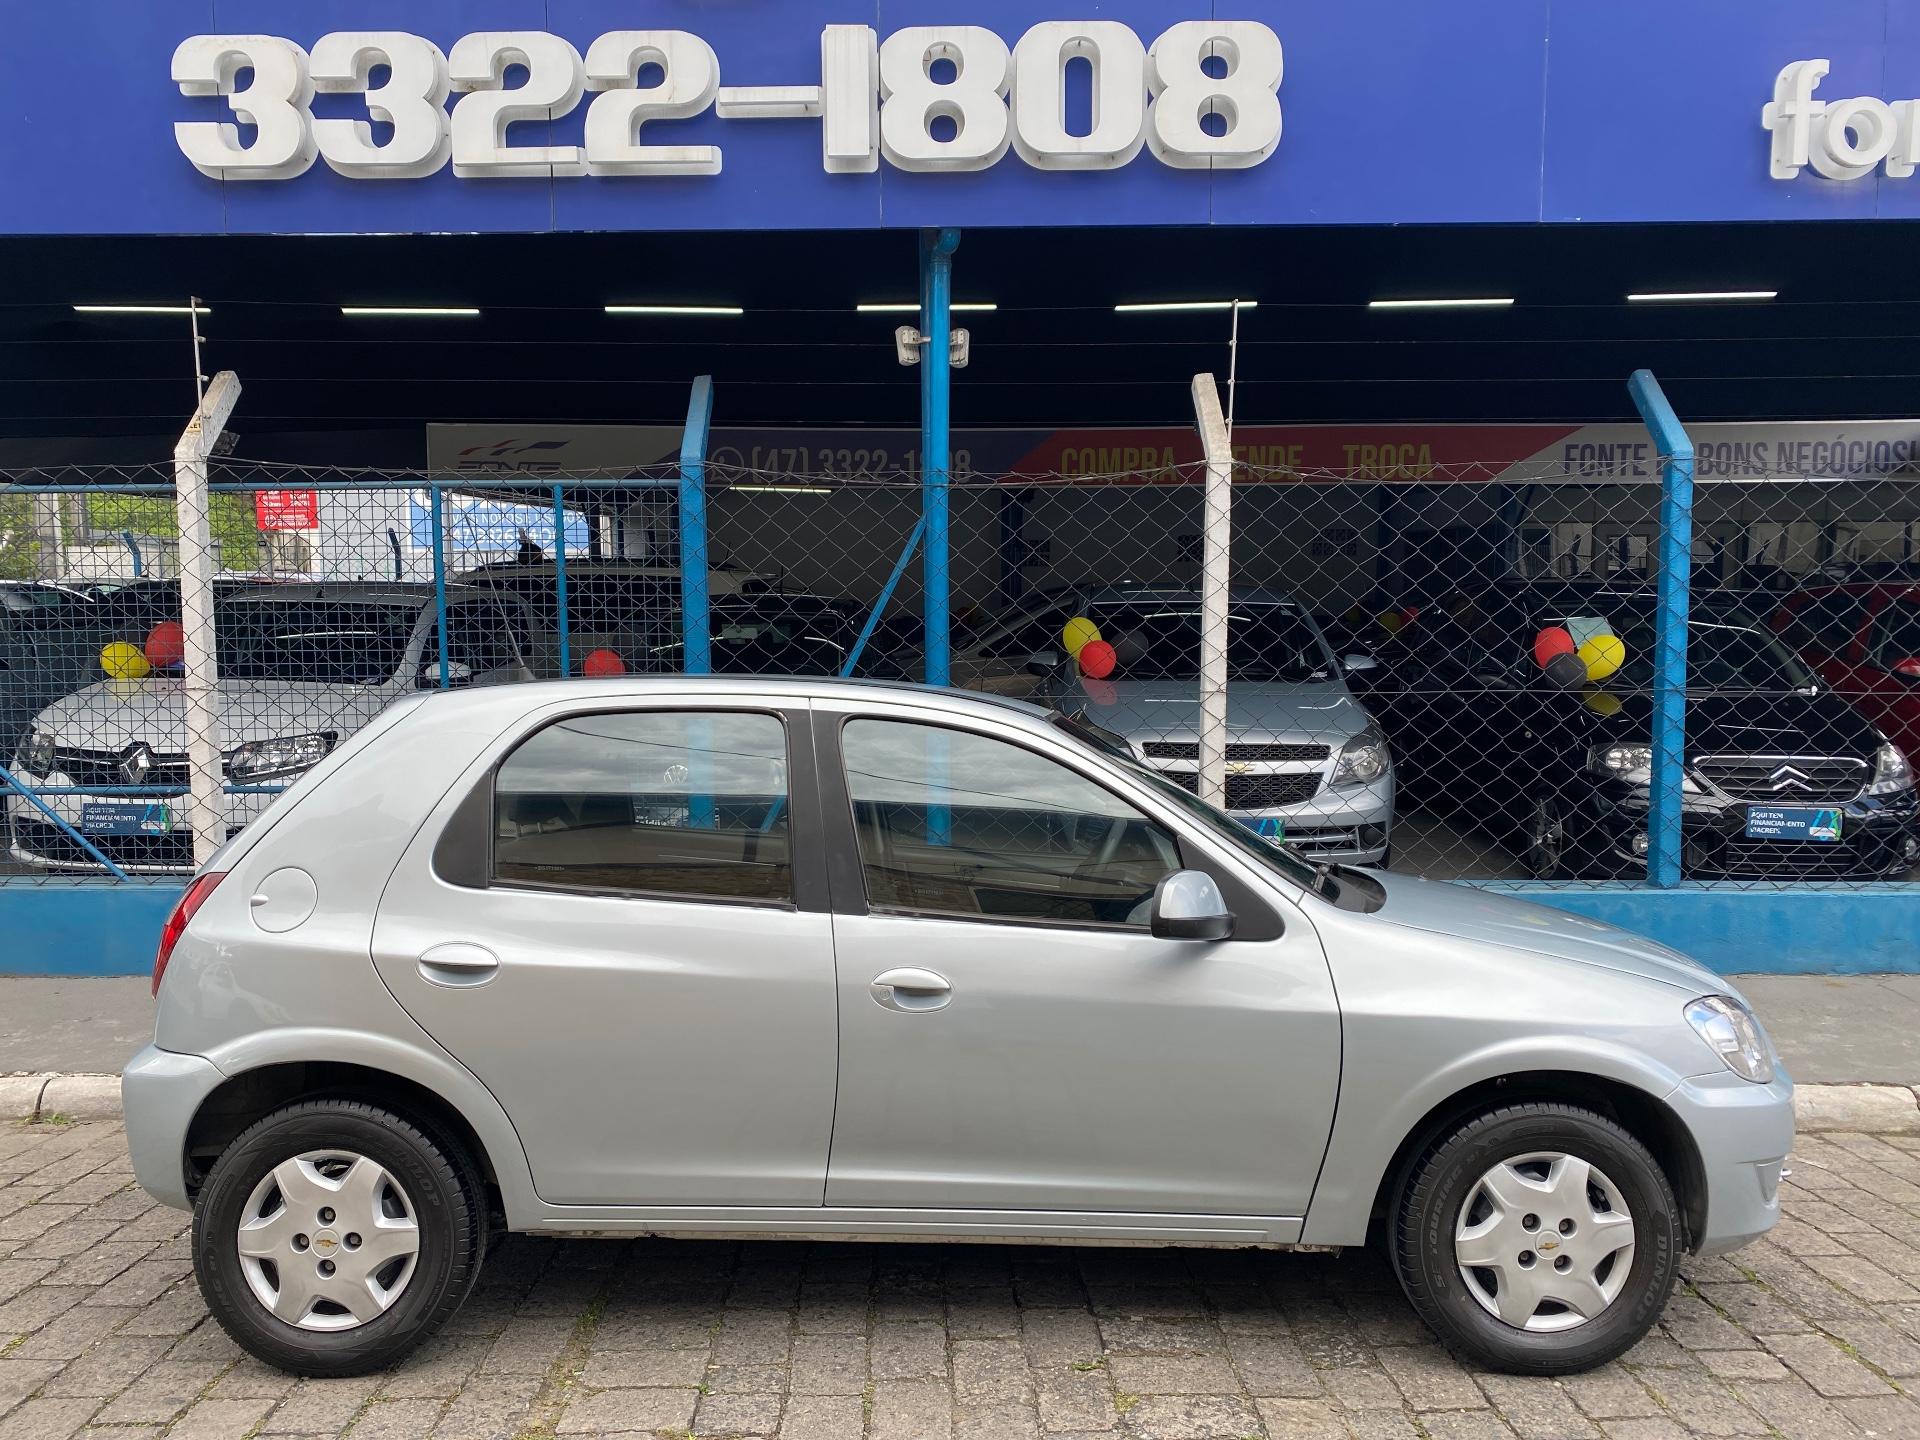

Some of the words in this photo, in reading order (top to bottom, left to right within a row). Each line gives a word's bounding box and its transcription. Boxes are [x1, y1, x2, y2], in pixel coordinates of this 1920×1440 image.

[171, 20, 1284, 180] 3322-1808
[750, 447, 809, 483] (47)
[1060, 446, 1178, 482] COMPRA
[1230, 445, 1304, 481] ENDE
[1342, 443, 1434, 480] TROCA
[1564, 443, 1649, 477] FONTE
[1697, 441, 1769, 476] BONS
